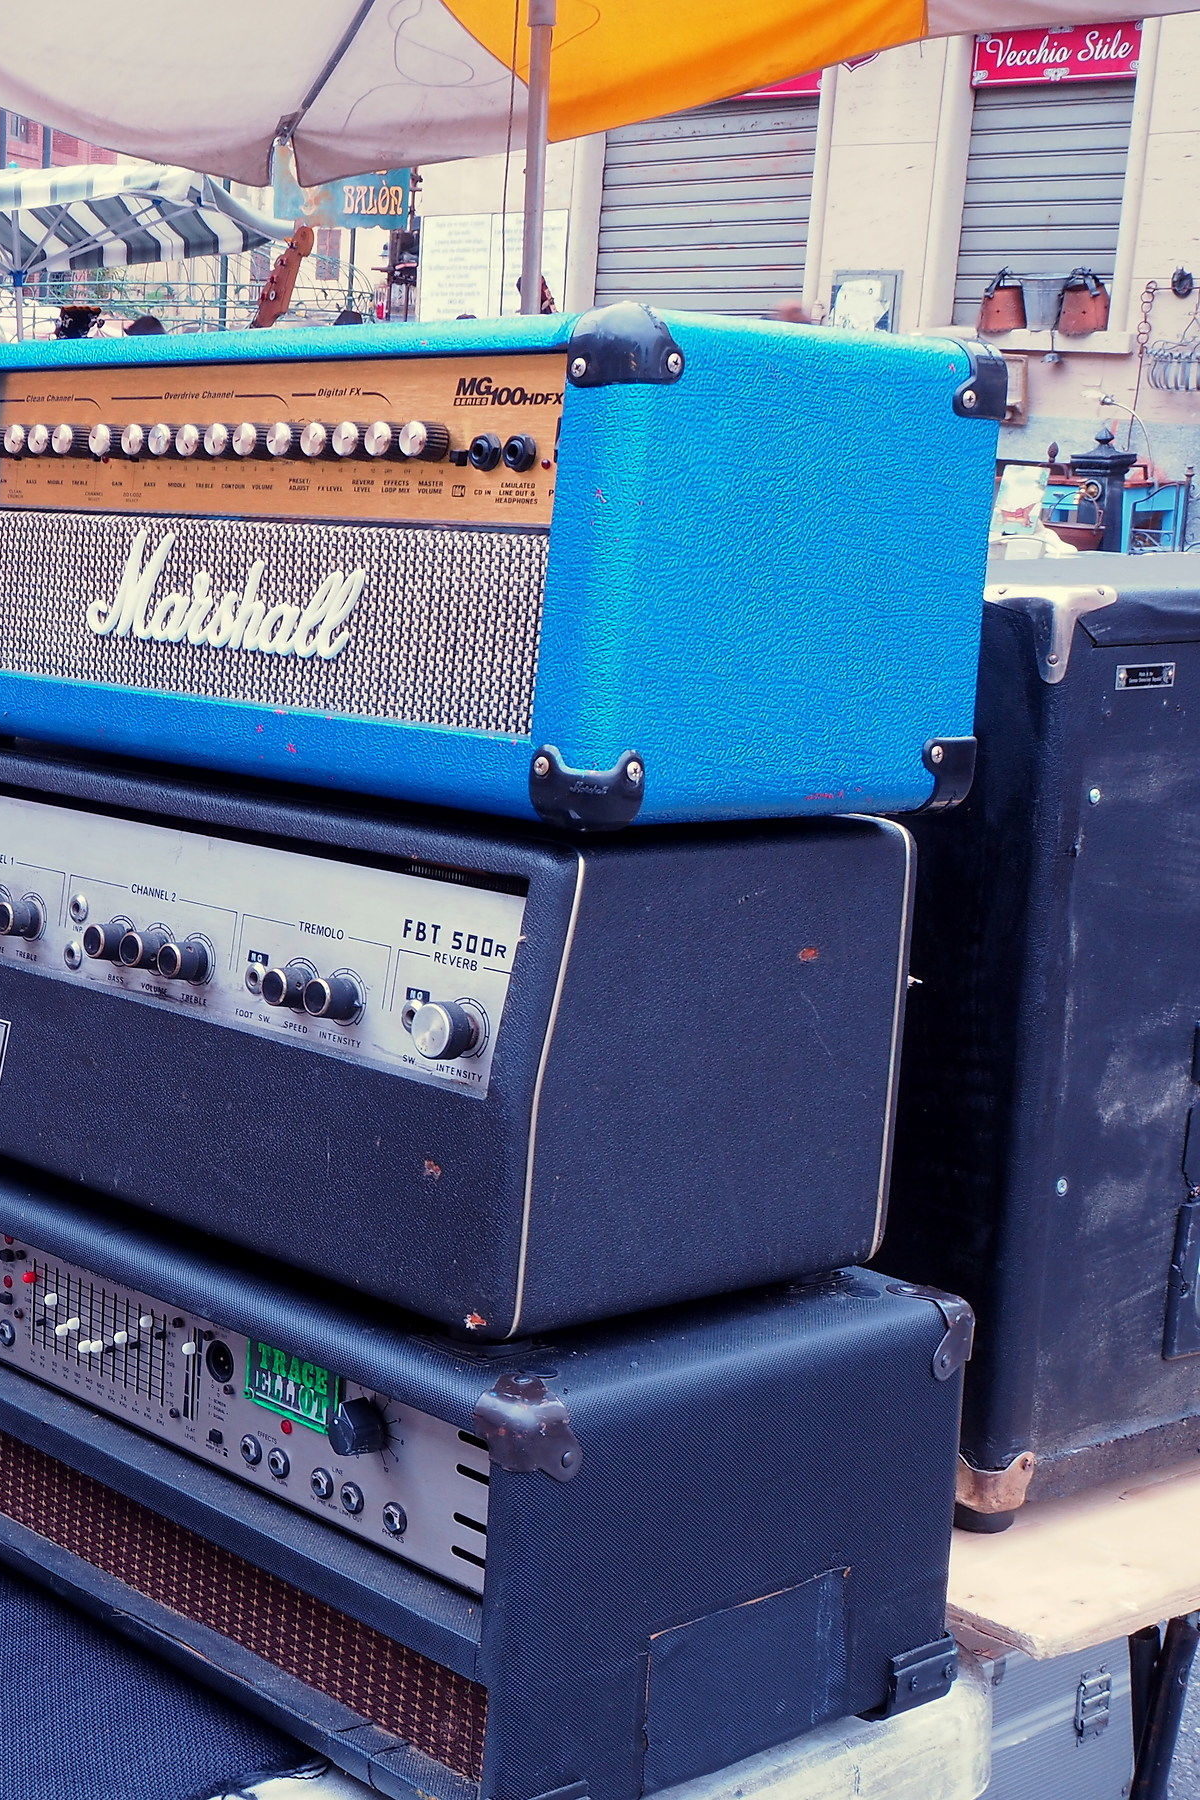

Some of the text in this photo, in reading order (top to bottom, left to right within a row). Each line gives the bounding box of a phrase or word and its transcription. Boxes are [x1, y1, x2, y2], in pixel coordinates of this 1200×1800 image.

[985, 29, 1134, 68] Vecchio Stile
[342, 181, 403, 216] BALÒN
[25, 392, 75, 403] Clean Channel
[163, 389, 235, 400] Overdrive Channel
[317, 387, 362, 398] Digital FX
[453, 397, 488, 407] SERIES
[494, 497, 538, 505] HEADPHONES
[86, 529, 366, 660] Marshall
[131, 884, 177, 902] CHANNEL 2
[298, 921, 344, 940] TREMOLO
[402, 918, 507, 959] FBT 500R
[15, 950, 38, 962] TREBLE
[433, 952, 478, 972] REVERB
[107, 973, 124, 984] BASS
[141, 982, 168, 997] VOLUME
[181, 992, 208, 1007] TREBLE
[235, 1008, 253, 1021] FOOT
[284, 1020, 308, 1035] SPEED
[318, 1031, 362, 1049] INTENSITY
[435, 1063, 483, 1083] INTENSITY
[258, 1342, 329, 1396] TRACE
[257, 1430, 278, 1445] EFFECTS
[332, 1466, 344, 1476] LINE
